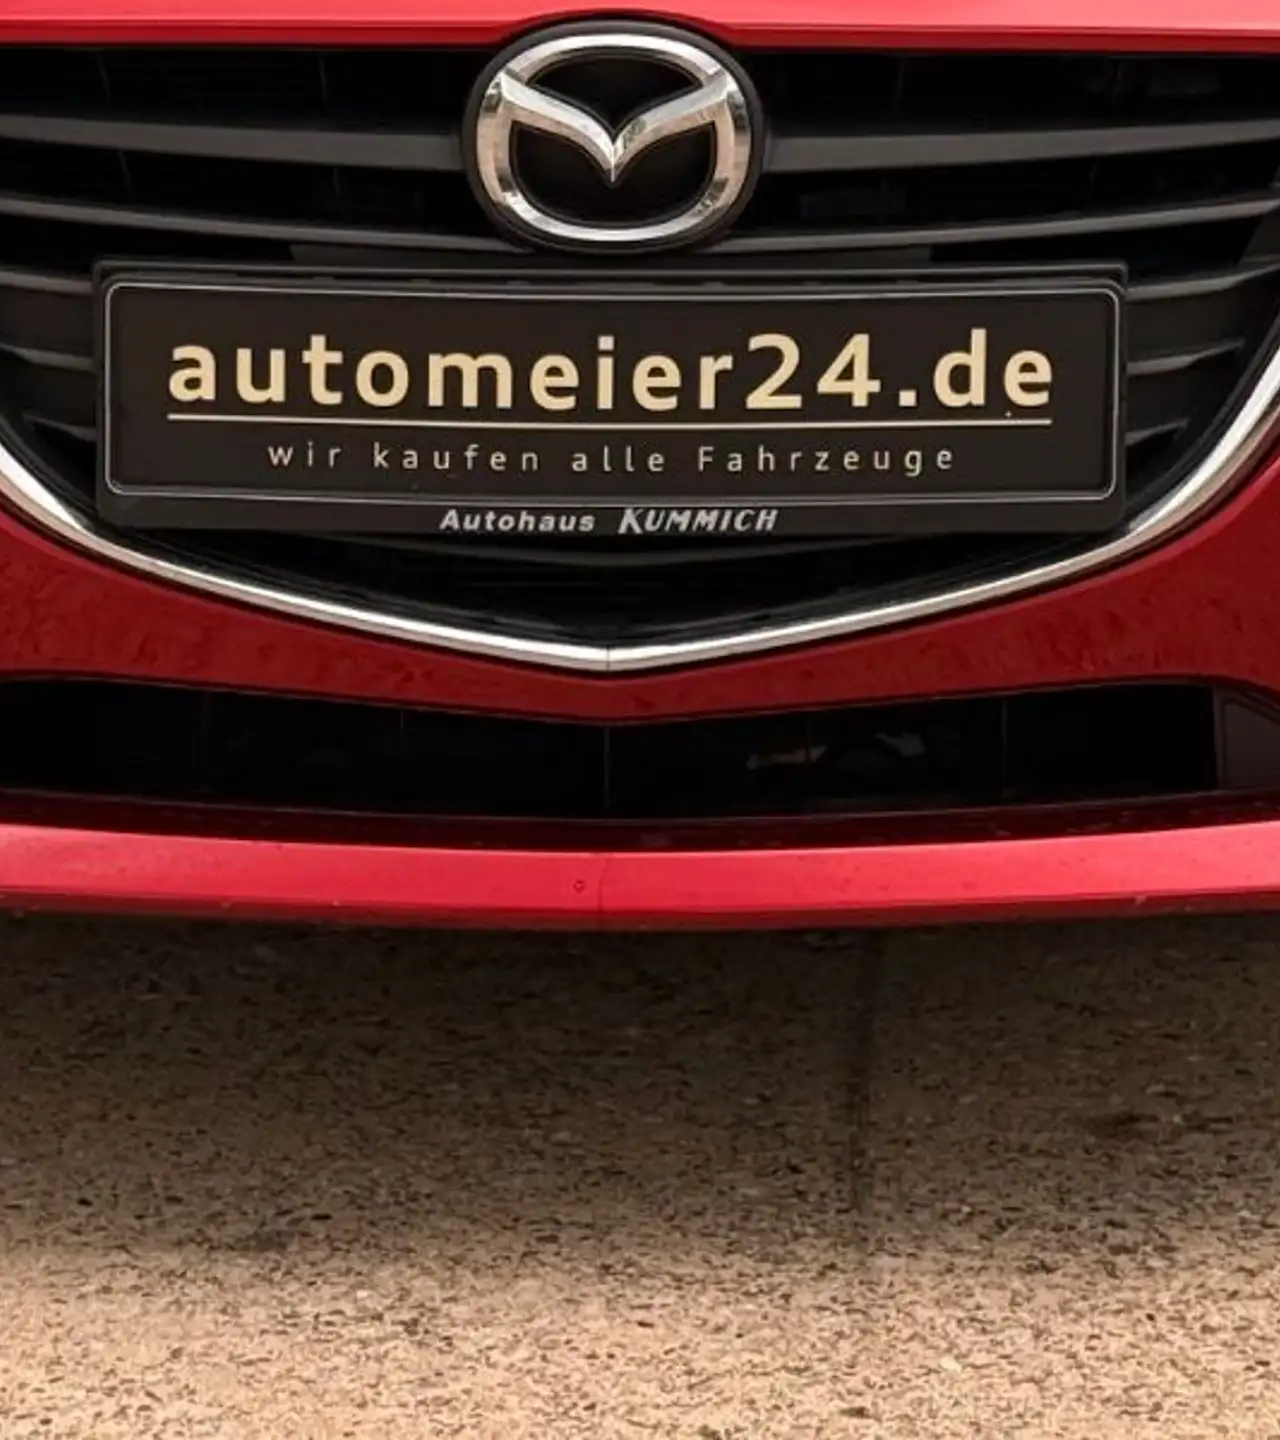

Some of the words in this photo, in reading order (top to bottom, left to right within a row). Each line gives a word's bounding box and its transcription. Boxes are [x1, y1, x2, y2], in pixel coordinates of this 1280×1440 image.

[168, 327, 1053, 411] automeier24.de
[267, 440, 343, 468] wir
[372, 441, 539, 472] kaufen
[571, 445, 666, 472] alle
[697, 444, 954, 478] Fahrzeuge
[438, 509, 596, 532] Autohaus
